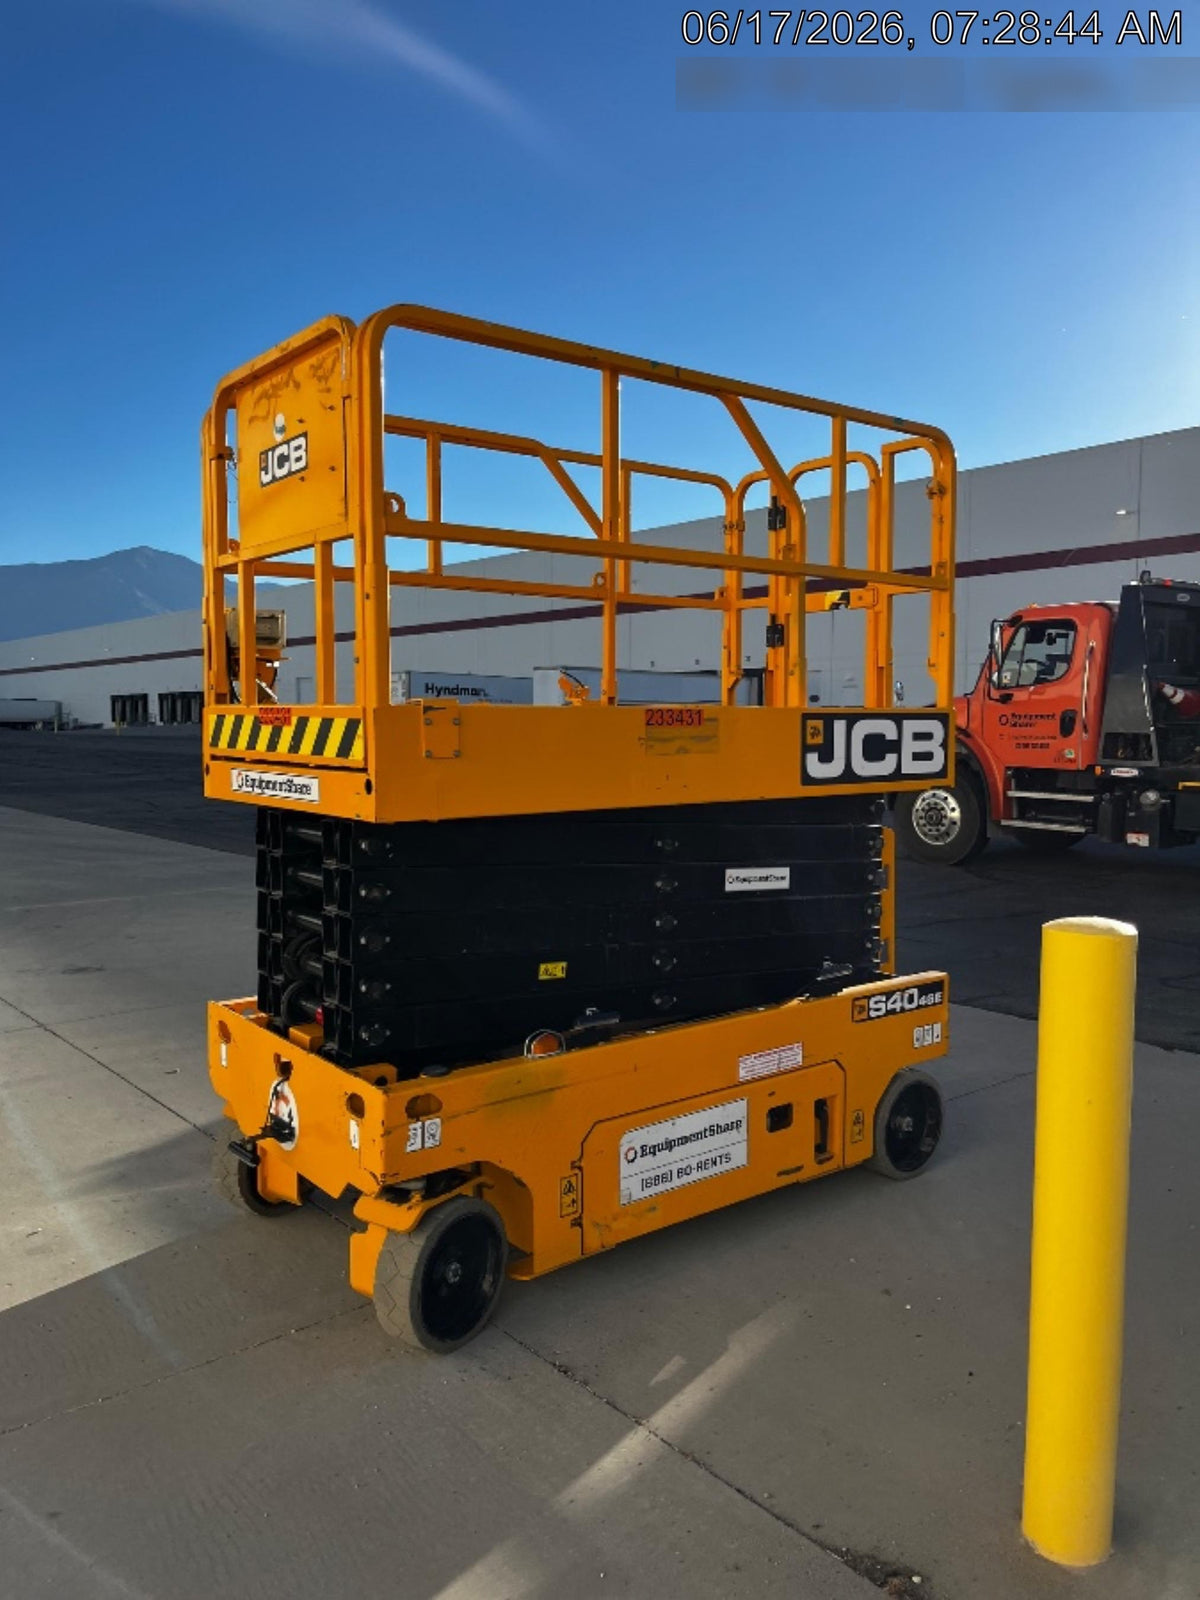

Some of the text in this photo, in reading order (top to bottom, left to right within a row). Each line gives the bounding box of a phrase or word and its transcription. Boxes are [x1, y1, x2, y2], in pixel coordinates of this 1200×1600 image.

[261, 436, 306, 484] JCB
[645, 708, 702, 726] 233431
[805, 719, 946, 779] JCB
[639, 1119, 743, 1160] EquipmentShare
